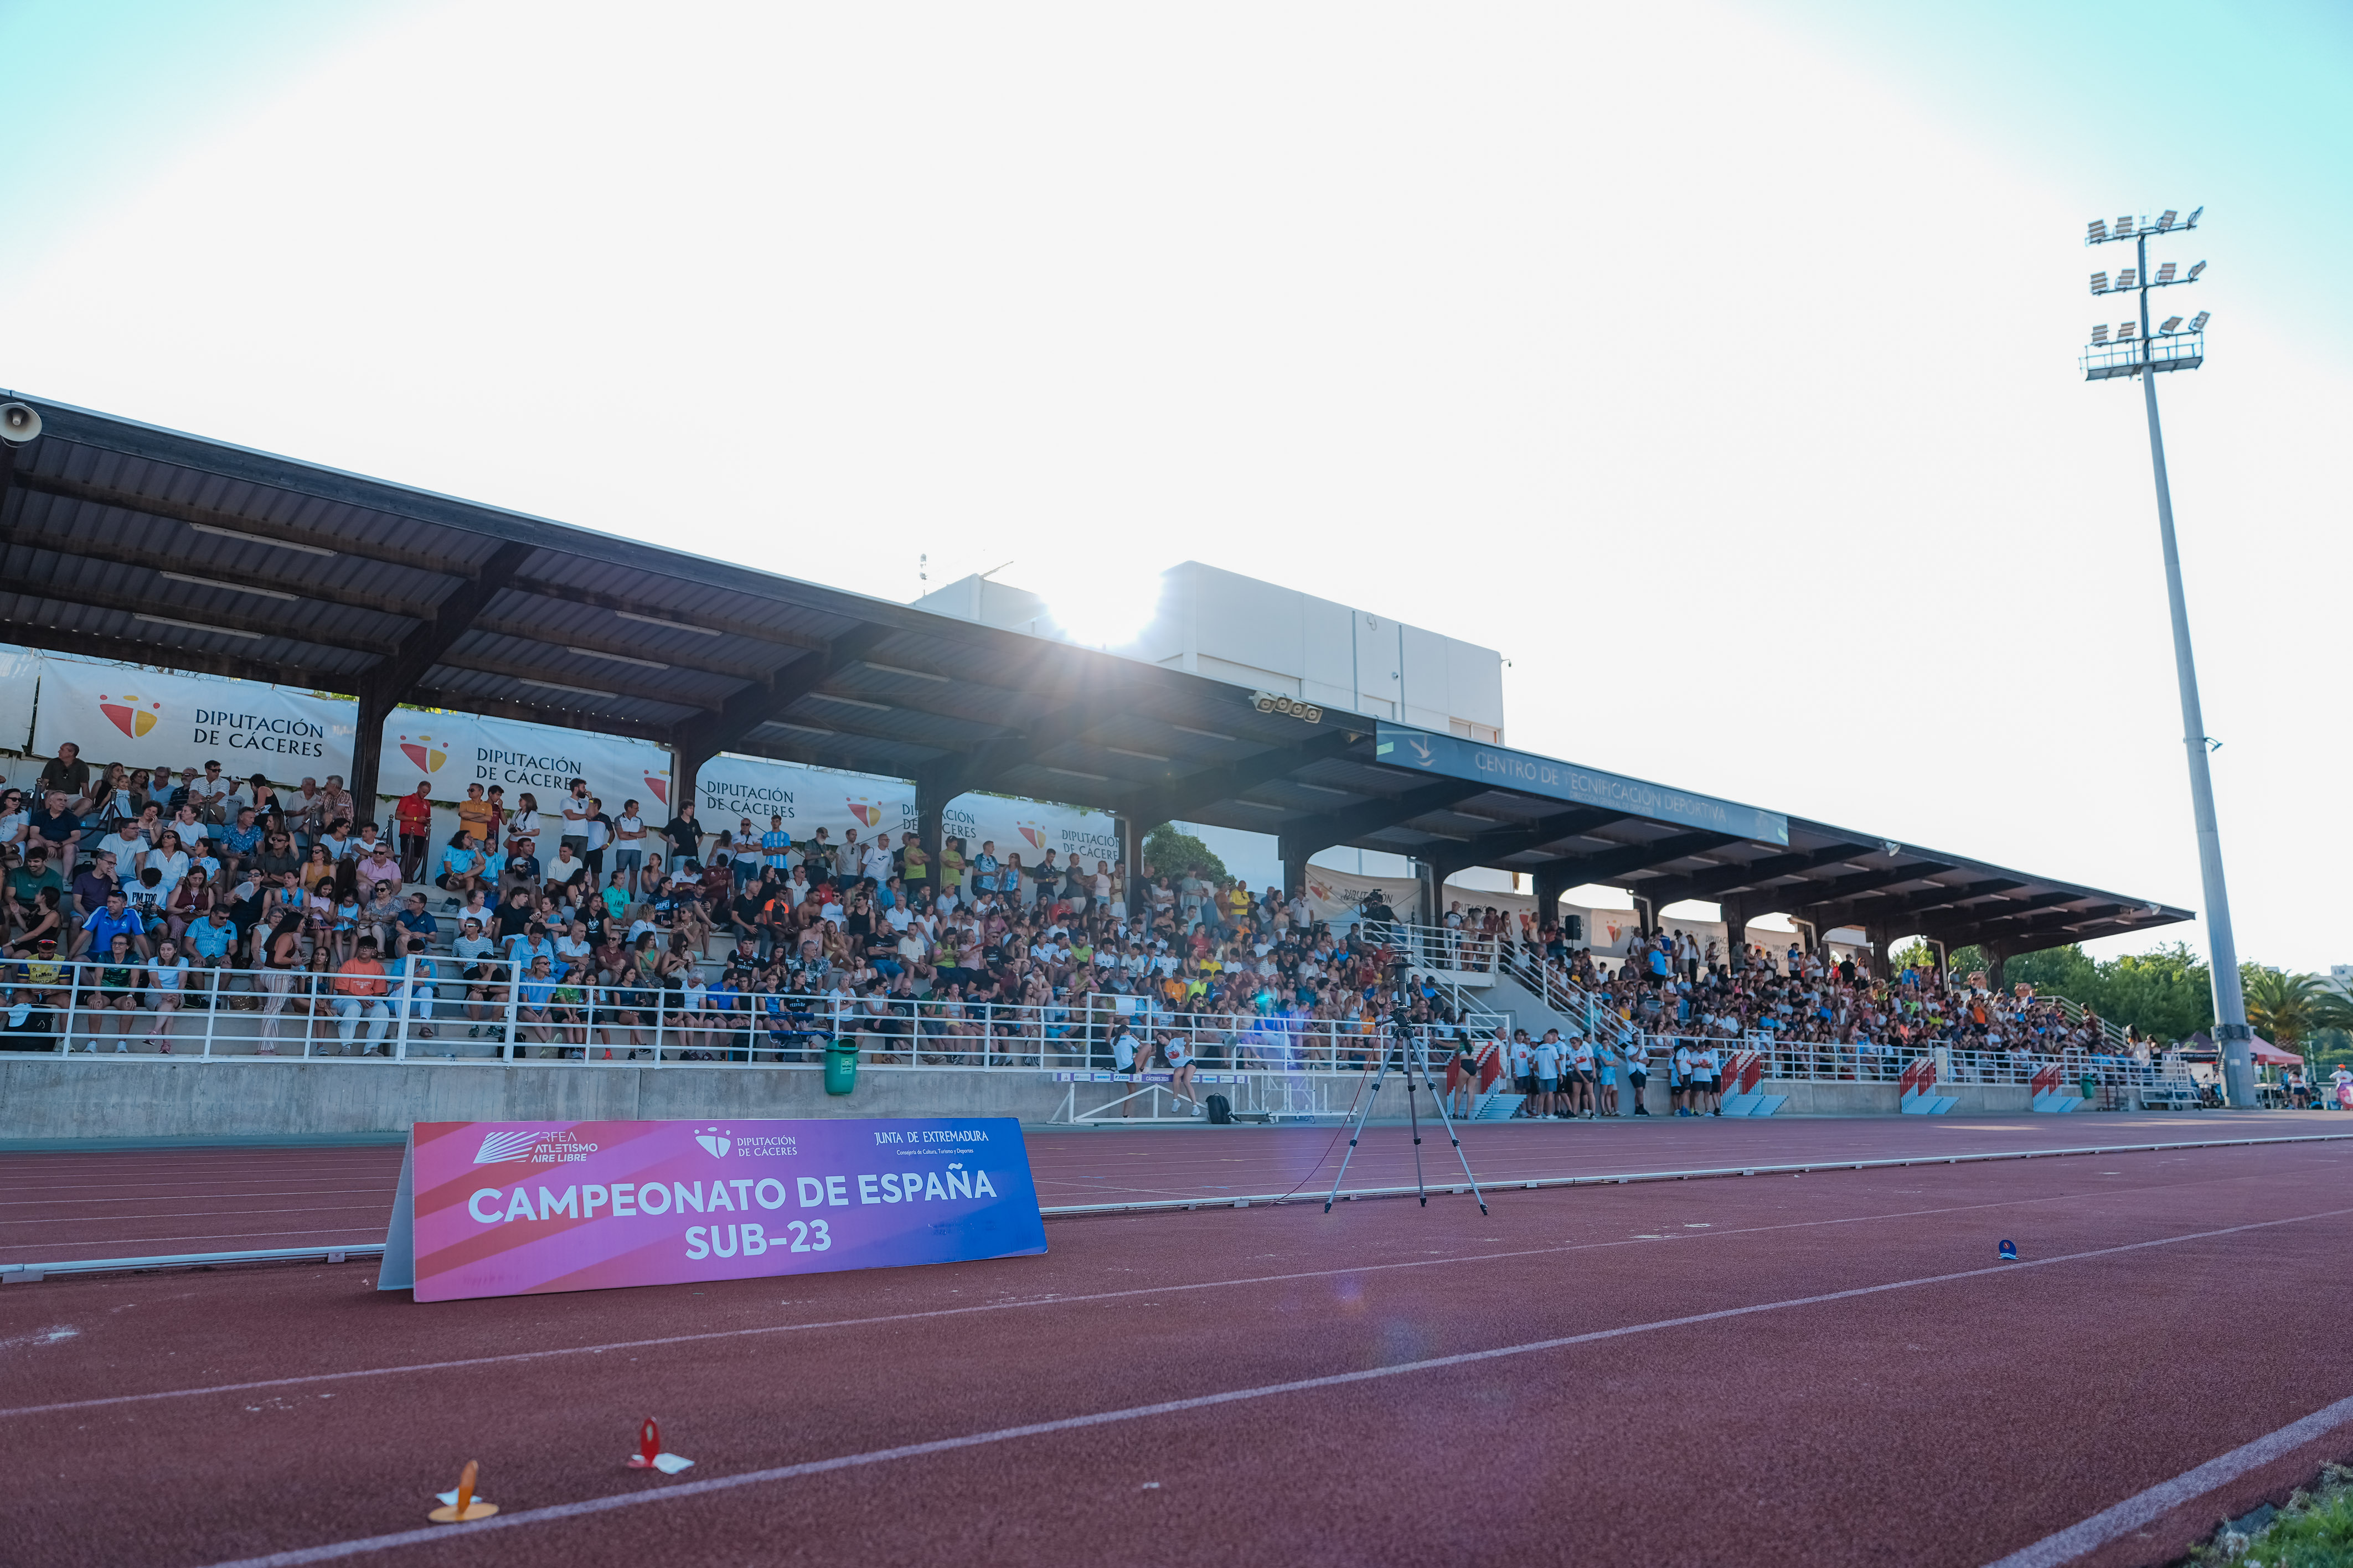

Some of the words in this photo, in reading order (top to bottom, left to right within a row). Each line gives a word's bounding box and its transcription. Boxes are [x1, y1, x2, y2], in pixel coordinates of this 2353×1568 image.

[196, 709, 324, 739] DIPUTACIÓN
[194, 728, 219, 744] DE
[229, 732, 323, 757] CÁCERES
[477, 748, 581, 775] DIPUTACIÓN
[476, 765, 497, 779] DE
[504, 768, 571, 790] CÁCERE
[1475, 751, 1536, 780] CENTRO
[1541, 767, 1559, 786] DE
[1664, 794, 1727, 823] DEPORTIVA
[707, 781, 793, 803] DIPUTACIÓN
[707, 796, 725, 810] DE
[730, 799, 795, 818] CÁCERES
[903, 819, 919, 831] DE
[942, 823, 976, 838] CERES
[1079, 845, 1119, 860] CÁCERE
[133, 892, 143, 903] I'M
[540, 1131, 577, 1142] RFEA
[737, 1135, 796, 1146] DIPUTACIÓN
[874, 1132, 904, 1146] JUNTA
[907, 1131, 920, 1143] DE
[922, 1130, 989, 1142] EXTREMADURA
[531, 1154, 555, 1162] AIRE
[557, 1153, 587, 1162] LIBRE
[535, 1143, 598, 1153] ATLETISMO
[738, 1148, 751, 1157] DE
[754, 1146, 798, 1156] CÁCERES
[468, 1177, 786, 1224] CAMPEONATO
[796, 1176, 849, 1208] DE
[857, 1163, 997, 1204] ESPAÑA
[685, 1219, 832, 1260] SUB-23
